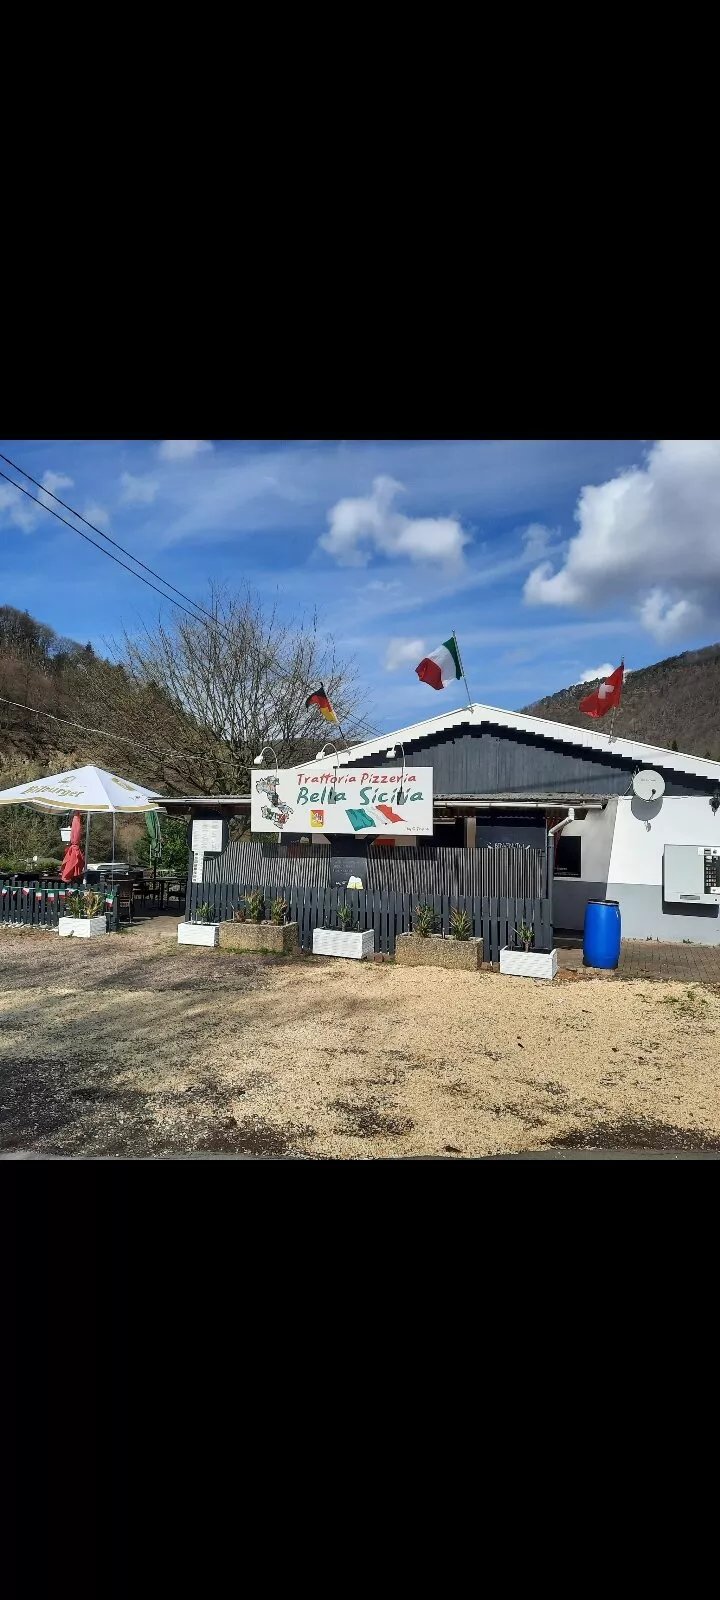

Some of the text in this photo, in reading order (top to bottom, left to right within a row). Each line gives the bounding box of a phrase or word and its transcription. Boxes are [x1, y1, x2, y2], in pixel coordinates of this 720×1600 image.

[297, 773, 416, 785] Trattoria Pizzeria
[297, 786, 347, 805] Bella
